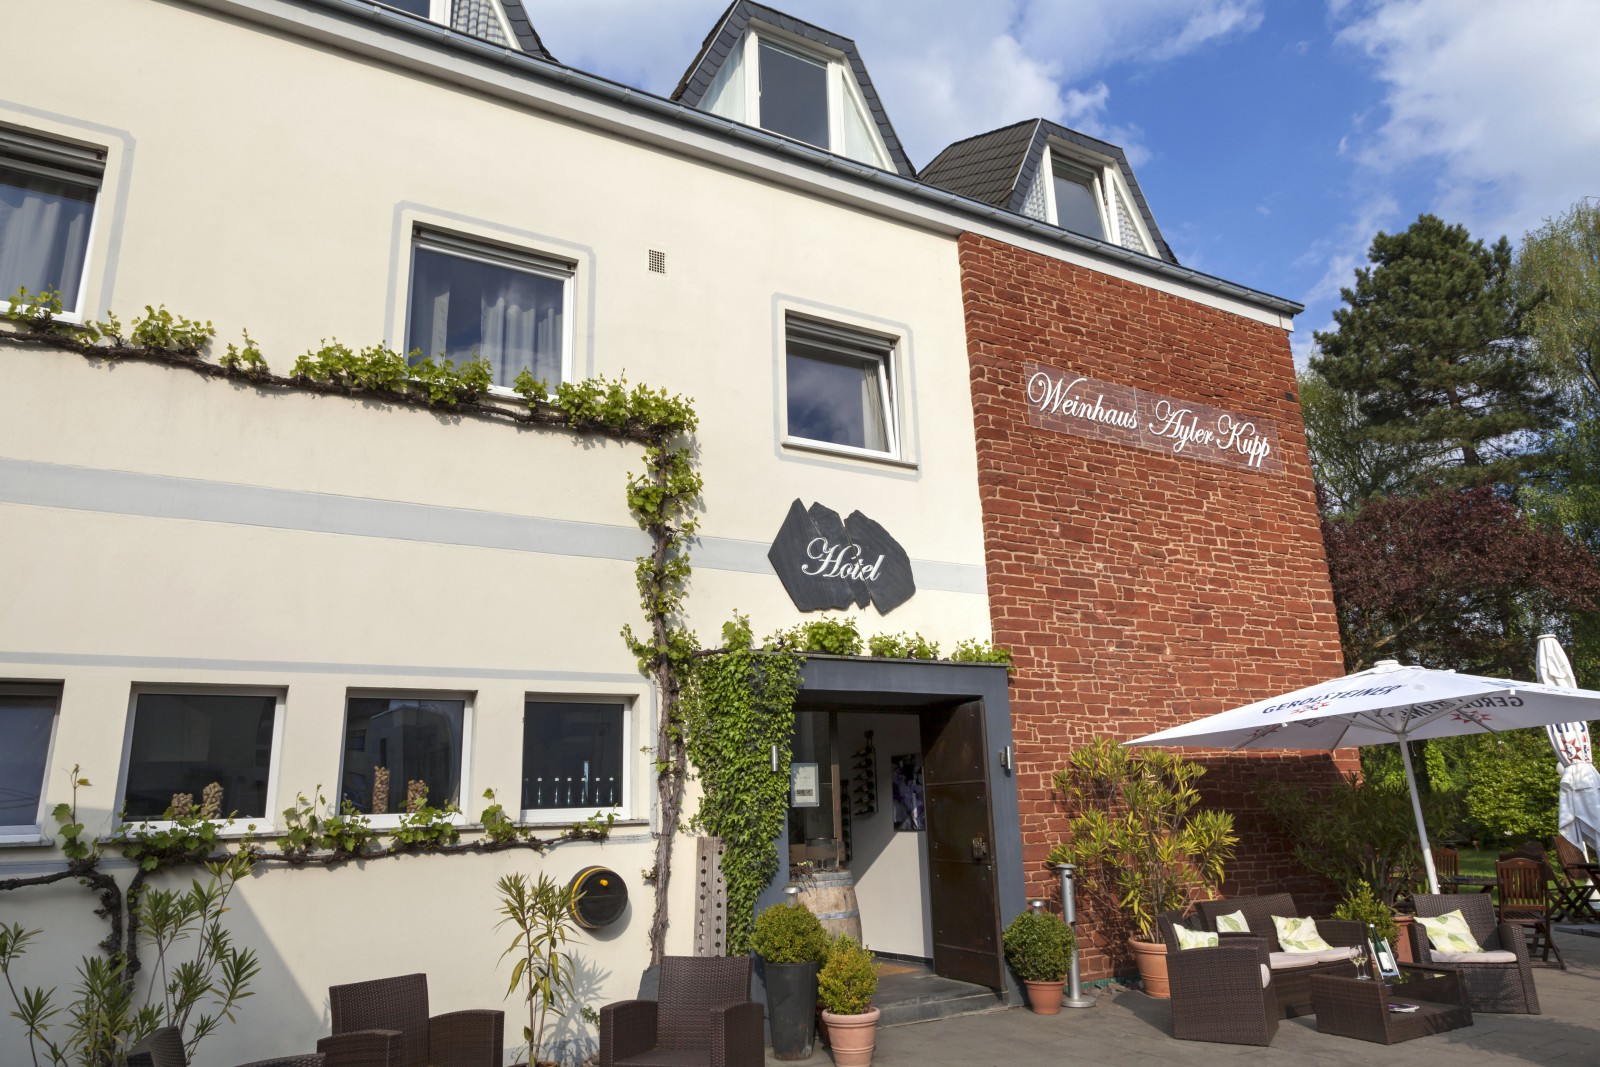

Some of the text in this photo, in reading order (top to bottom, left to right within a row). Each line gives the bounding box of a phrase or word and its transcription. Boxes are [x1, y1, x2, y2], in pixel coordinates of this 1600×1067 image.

[1027, 372, 1271, 468] Weinhaus Ayler Kupp
[801, 537, 885, 582] Hotel
[1262, 684, 1406, 714] GEROLSTEINER
